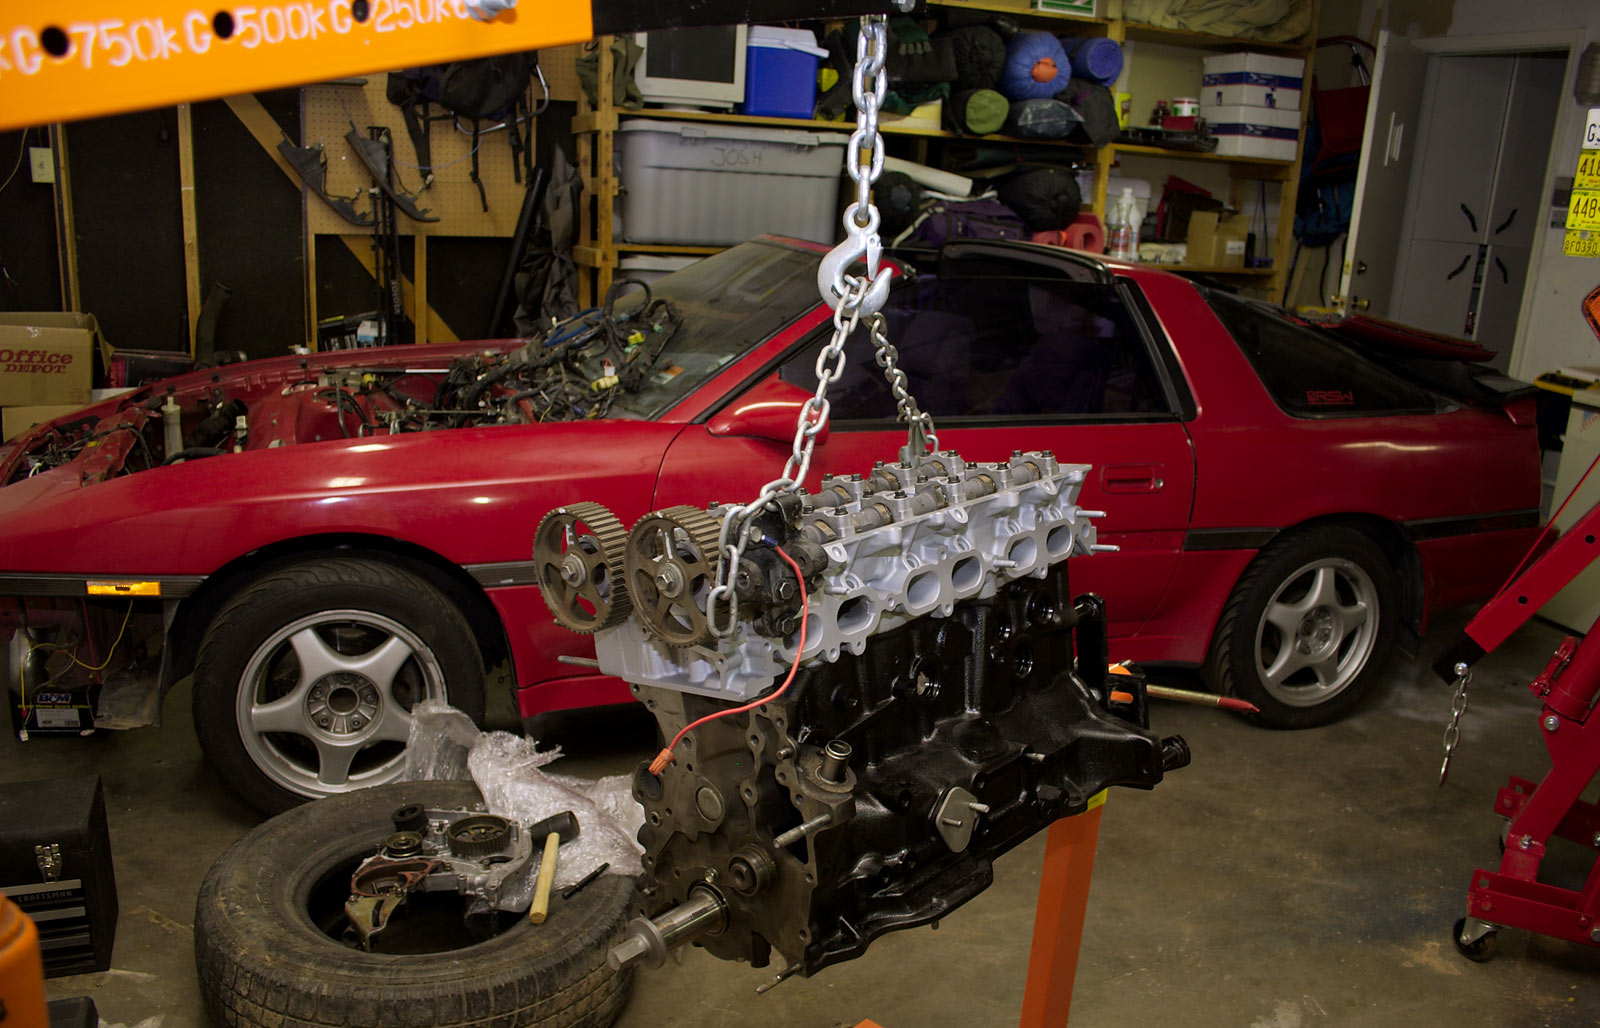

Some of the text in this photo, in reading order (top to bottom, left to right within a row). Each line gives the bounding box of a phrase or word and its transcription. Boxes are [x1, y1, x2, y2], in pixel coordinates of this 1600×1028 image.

[710, 147, 763, 167] JOSH
[1573, 198, 1598, 218] 448
[0, 349, 73, 364] Office
[4, 364, 66, 374] DEPOT
[17, 890, 73, 903] CRAFTSMAN
